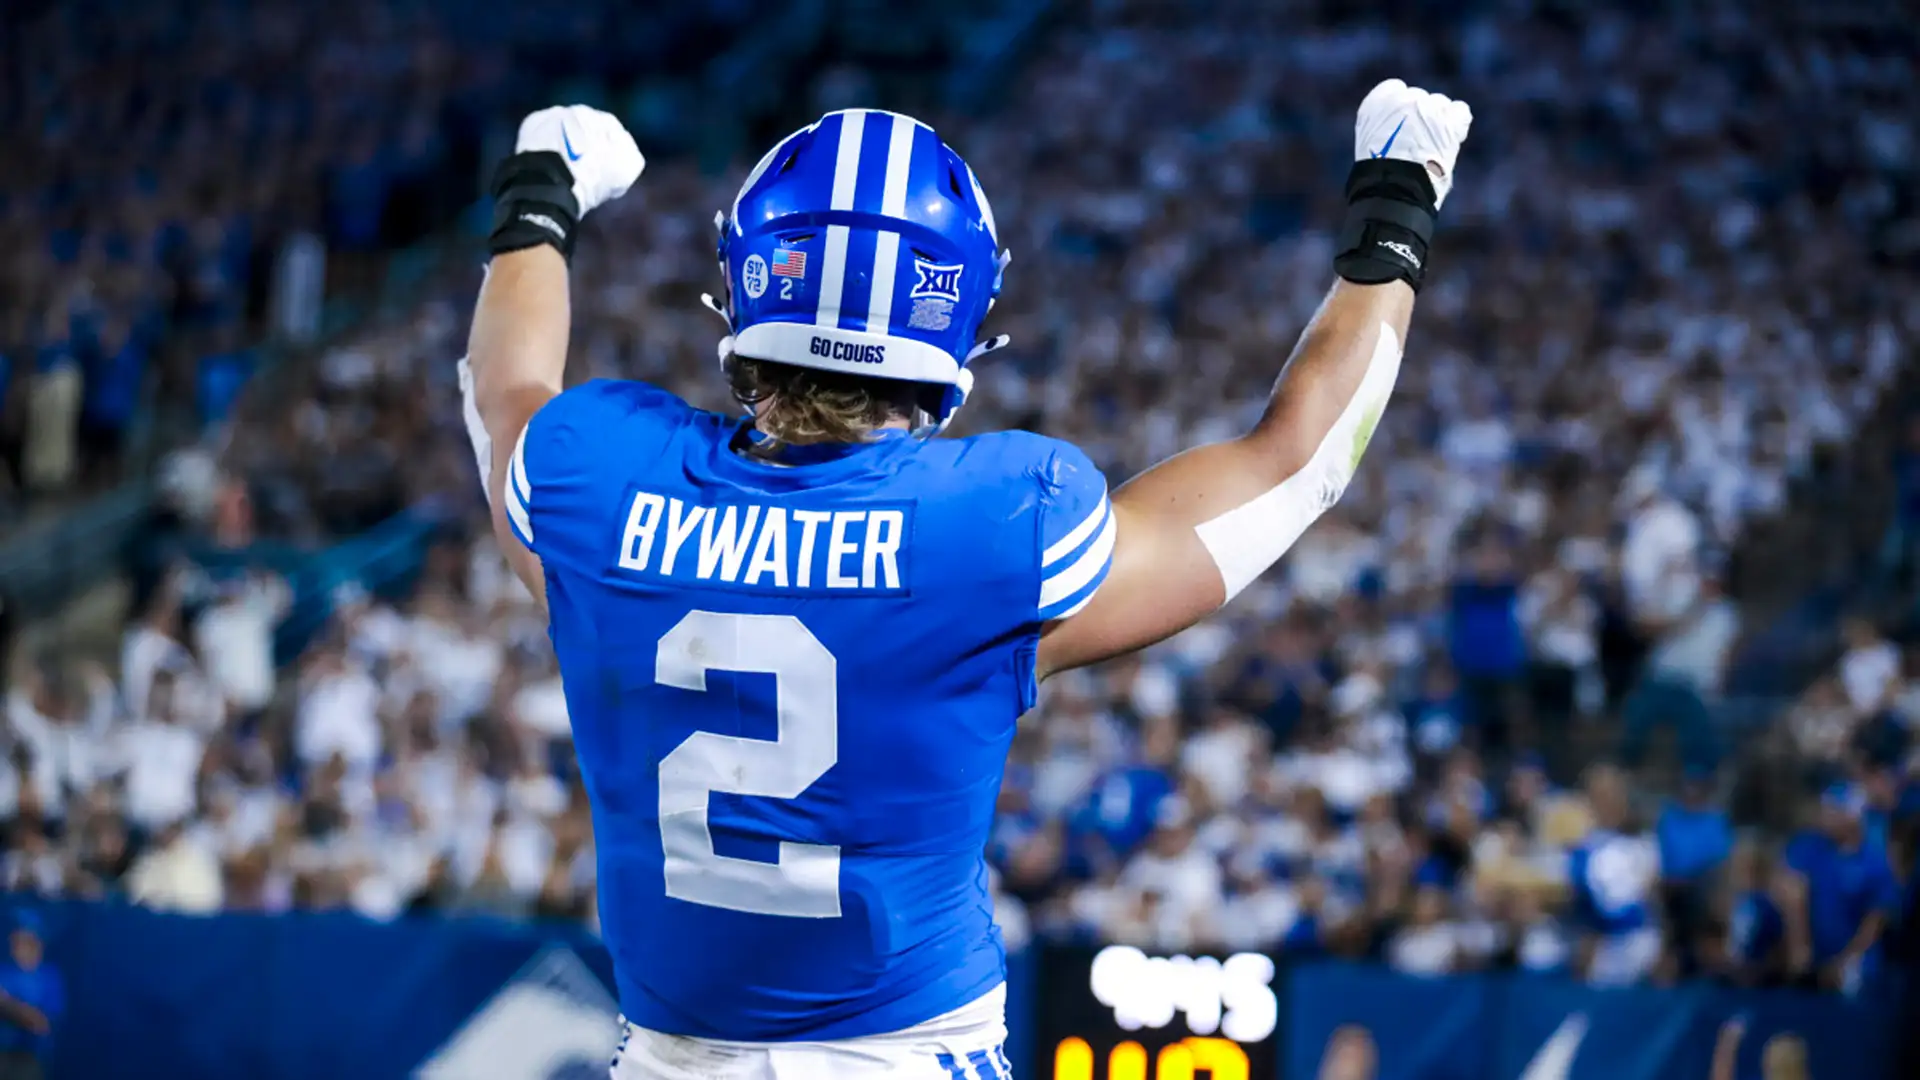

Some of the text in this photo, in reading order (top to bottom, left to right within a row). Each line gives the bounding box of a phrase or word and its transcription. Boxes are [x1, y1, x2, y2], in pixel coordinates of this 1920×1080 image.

[746, 260, 763, 276] SV
[915, 264, 961, 298] XII
[746, 276, 761, 292] 72
[780, 277, 793, 300] 2
[810, 336, 885, 363] GO COUGS
[618, 491, 903, 588] BYWATER
[655, 609, 842, 918] 2
